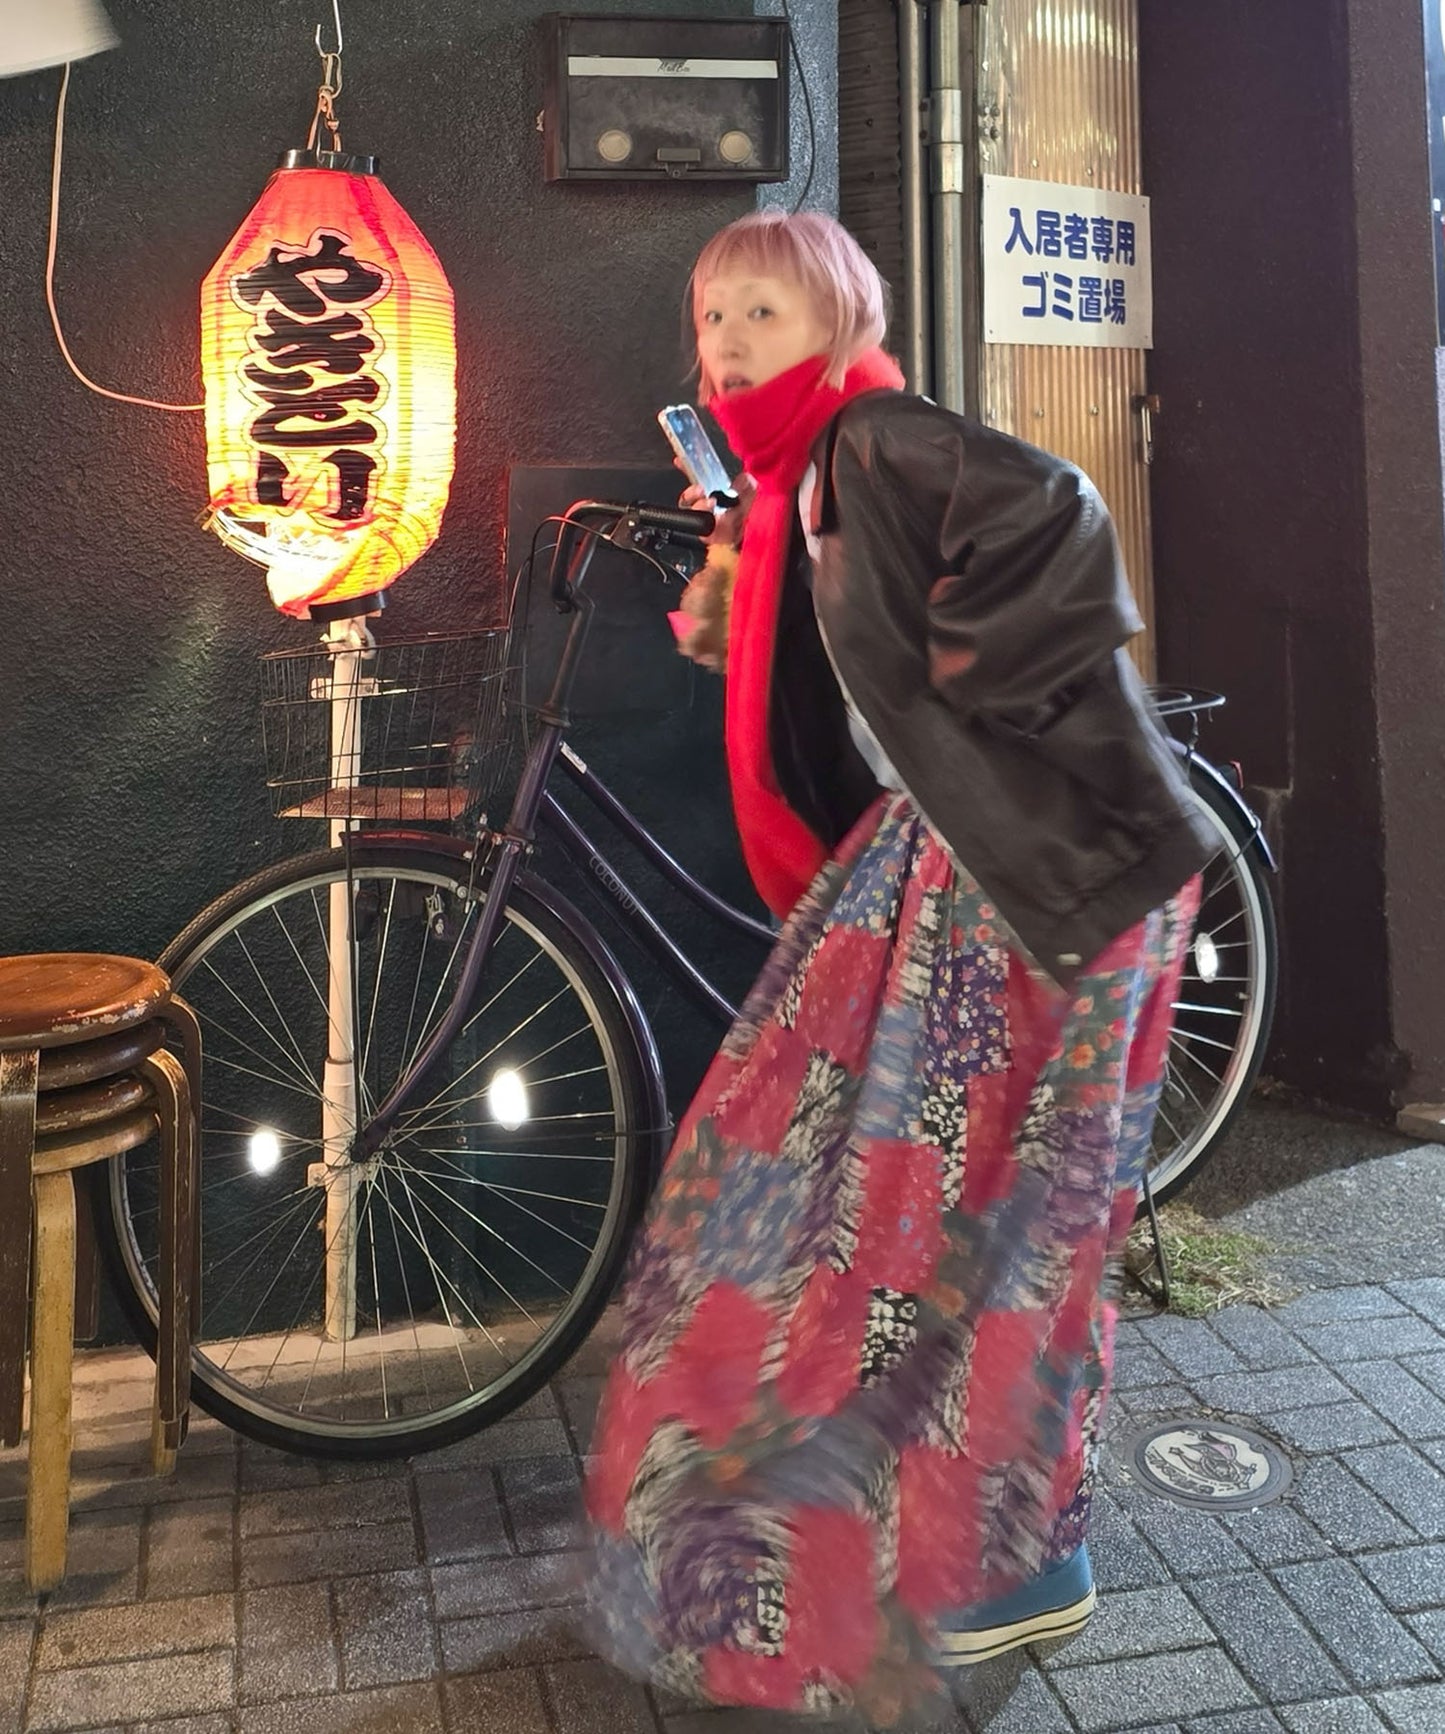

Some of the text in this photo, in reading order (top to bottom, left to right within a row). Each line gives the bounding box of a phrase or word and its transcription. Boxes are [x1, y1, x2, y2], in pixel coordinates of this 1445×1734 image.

[1004, 207, 1136, 266] 入居者専用
[1022, 271, 1126, 325] ゴミ置場
[233, 231, 386, 522] やきとり
[588, 855, 641, 916] COCONUT
